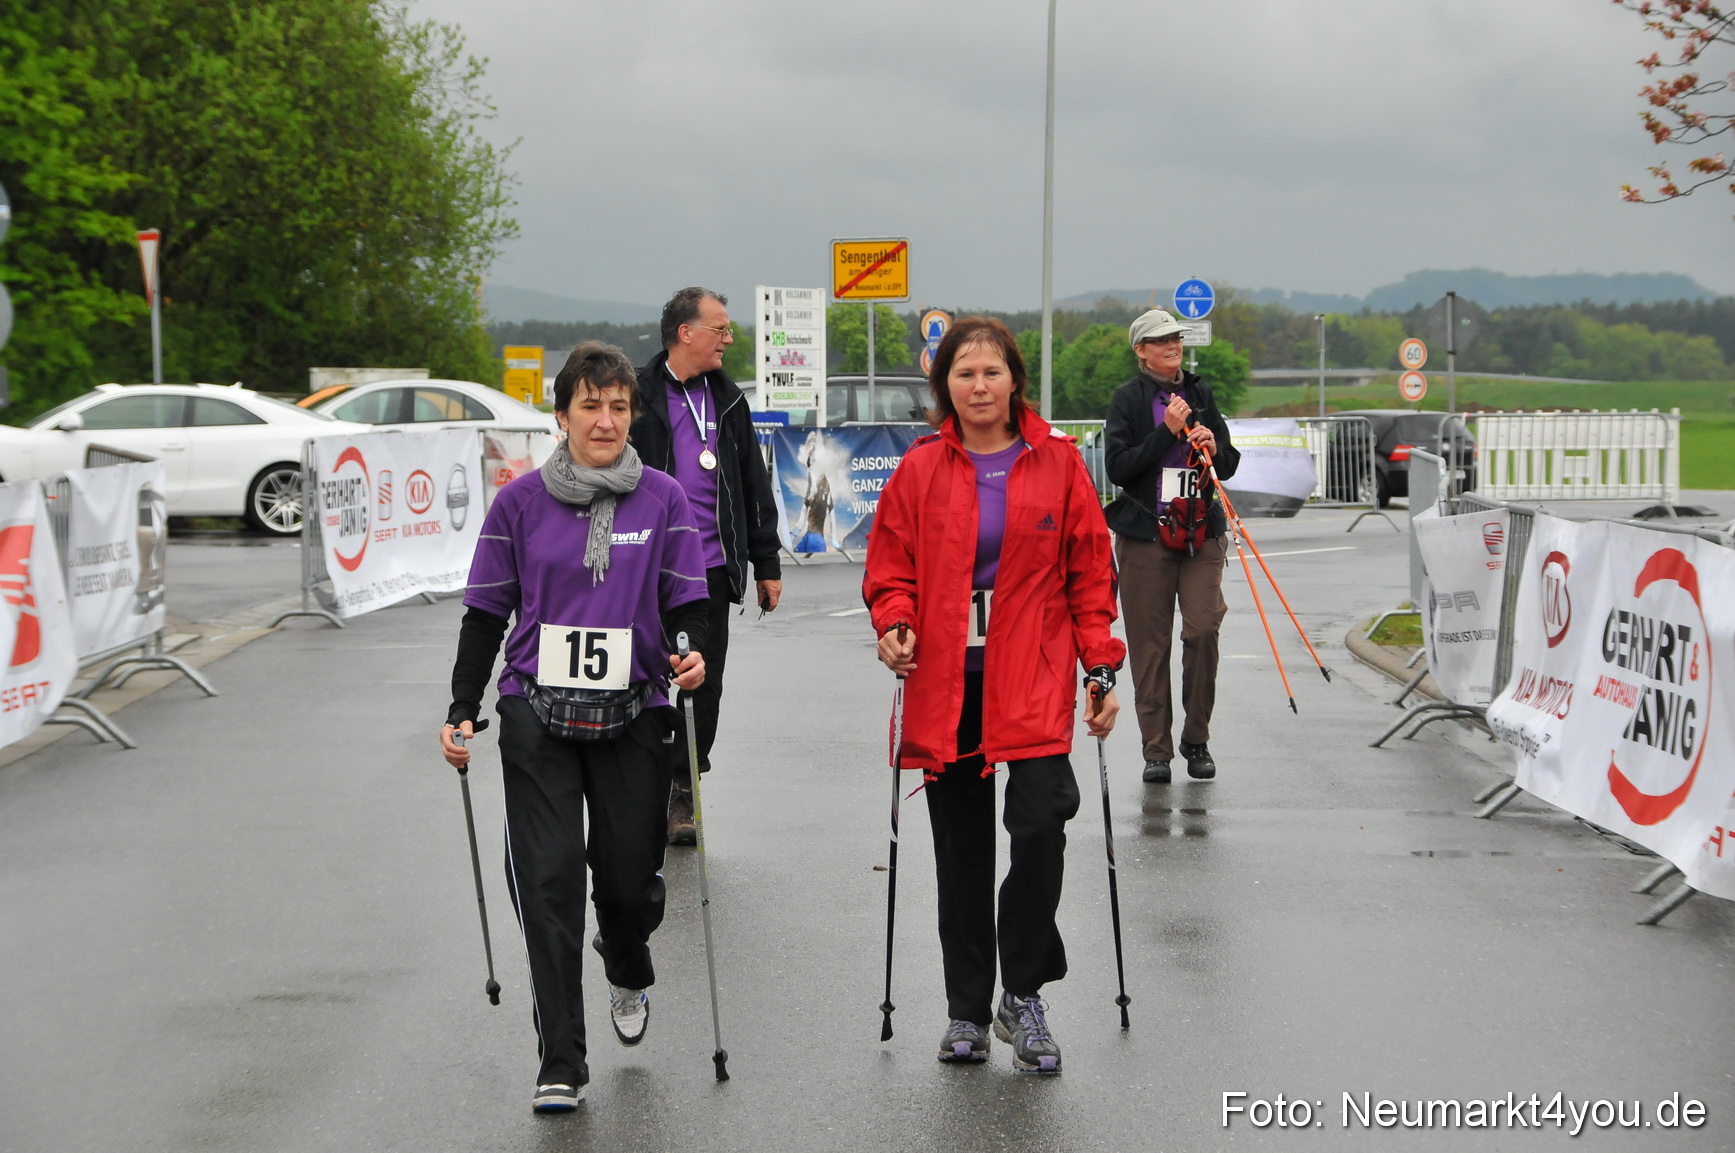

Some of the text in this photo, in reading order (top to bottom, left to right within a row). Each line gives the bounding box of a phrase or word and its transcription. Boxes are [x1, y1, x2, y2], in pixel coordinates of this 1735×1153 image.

[840, 249, 901, 267] Sengenthal
[1406, 347, 1421, 360] 60
[851, 456, 904, 471] SAISONST
[410, 480, 430, 504] KIA
[852, 478, 884, 493] GANZ
[1177, 470, 1198, 499] 16
[374, 527, 398, 543] SEAT
[402, 520, 442, 538] KIA MOTORS
[972, 591, 993, 637] 1
[1461, 631, 1474, 643] IST
[565, 630, 609, 681] 15
[0, 681, 51, 713] SEAT
[1593, 674, 1640, 710] AUTOHAUS
